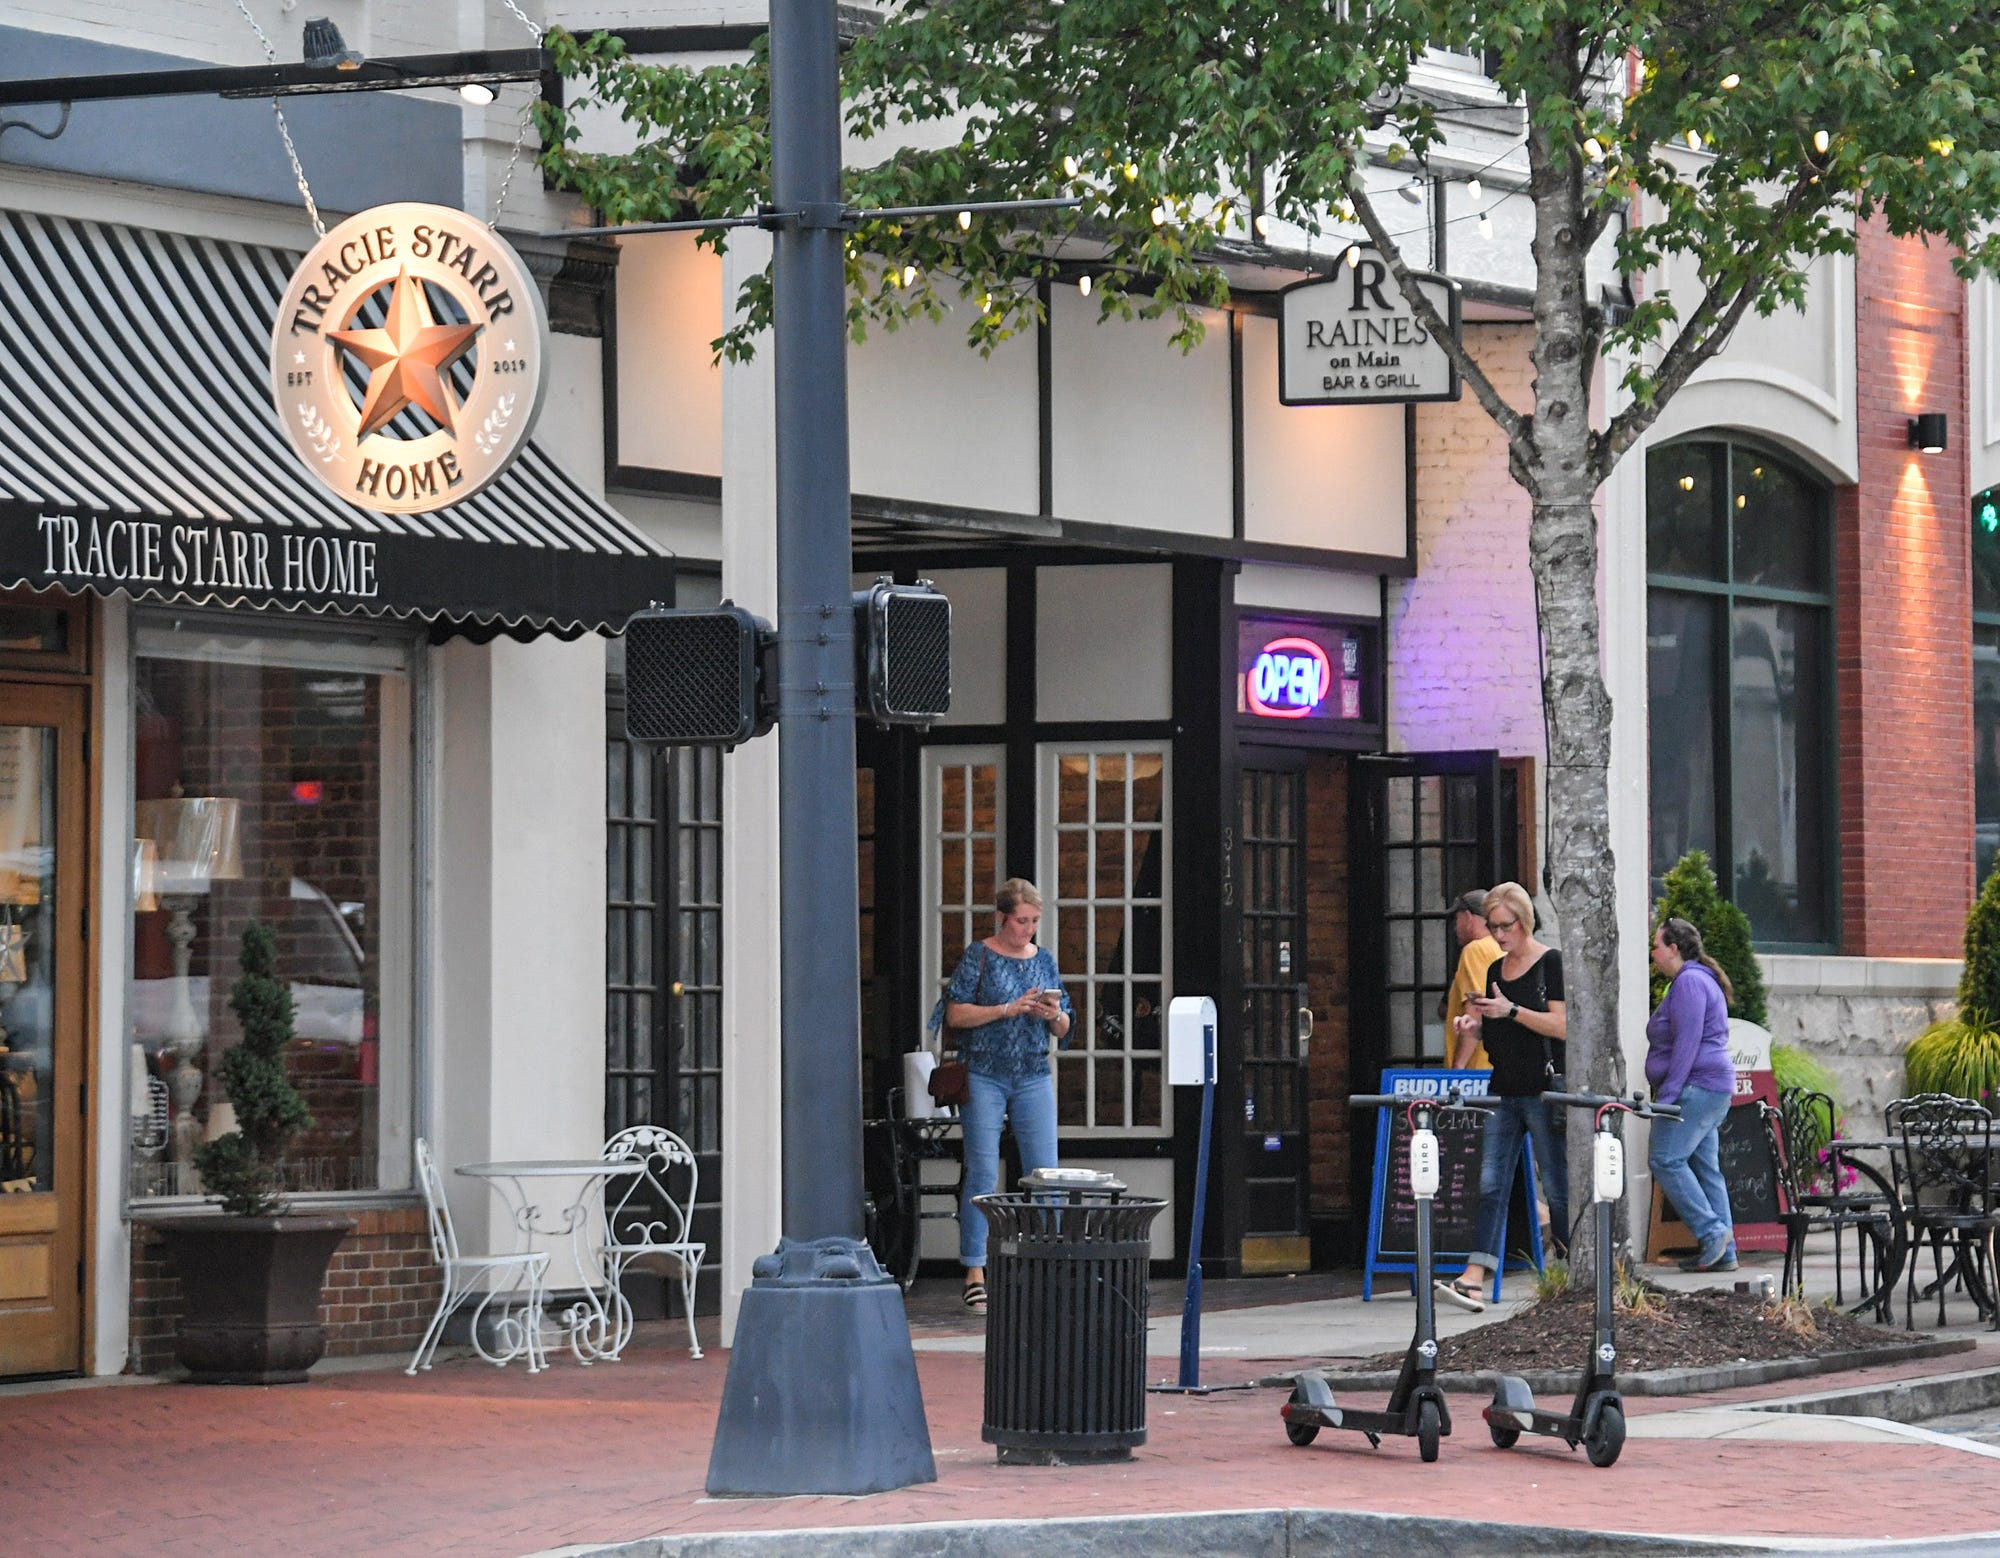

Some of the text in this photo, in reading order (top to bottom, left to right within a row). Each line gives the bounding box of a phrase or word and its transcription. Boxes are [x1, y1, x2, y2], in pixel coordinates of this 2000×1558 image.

[291, 225, 514, 337] TRACIE STARR
[1348, 259, 1395, 312] R
[1306, 316, 1429, 348] RAINES
[493, 359, 527, 374] 2019
[1330, 351, 1401, 369] on Main
[287, 371, 313, 387] EST
[1323, 373, 1420, 391] BAR & GRILL
[356, 450, 464, 500] HOME
[38, 512, 379, 597] TRACIE STARR HOME
[1255, 653, 1321, 708] OPEN
[1223, 826, 1233, 906] 312
[1395, 1078, 1490, 1097] BUD LGH
[1397, 1110, 1485, 1130] SCIAL
[1421, 1143, 1429, 1173] BIRD
